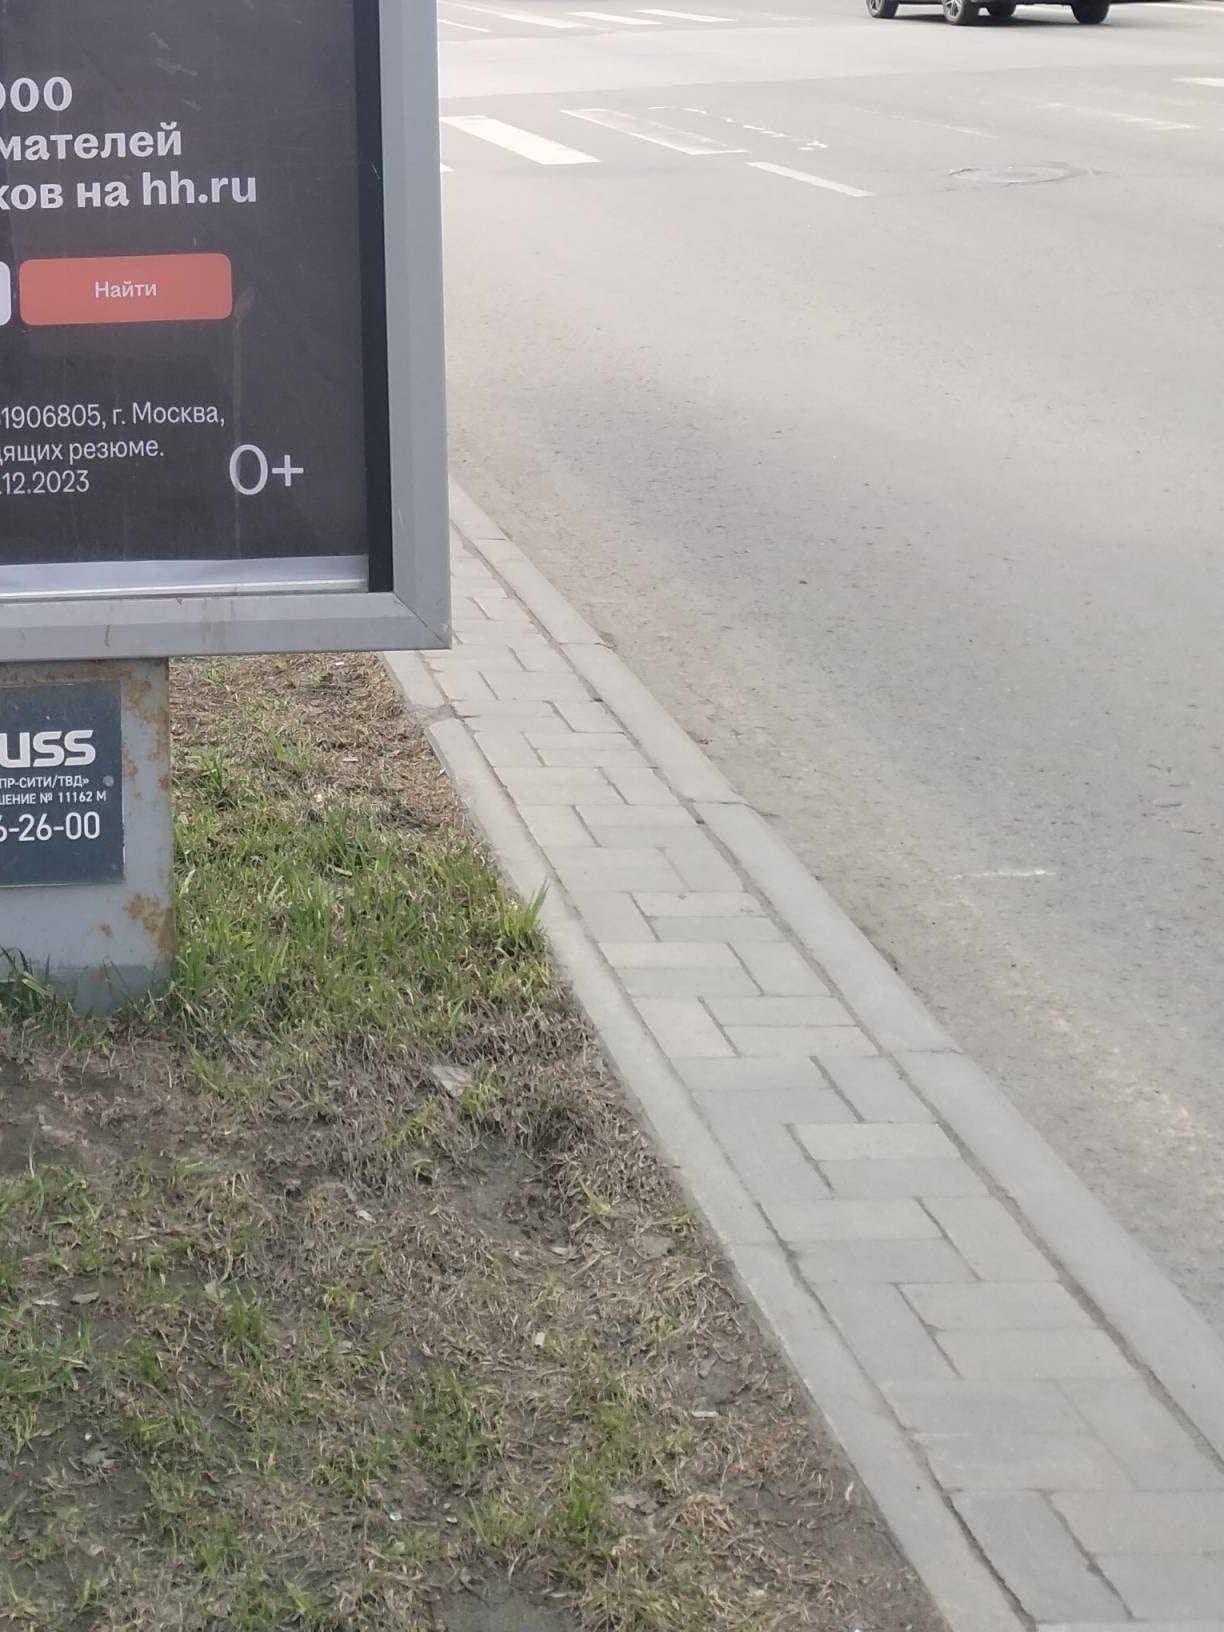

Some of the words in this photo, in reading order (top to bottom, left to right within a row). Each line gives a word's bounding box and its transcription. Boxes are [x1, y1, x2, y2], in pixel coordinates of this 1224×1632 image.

[76, 181, 130, 208] на
[142, 170, 257, 206] hh.ru
[95, 280, 157, 298] Найти
[112, 408, 126, 425] г.
[132, 401, 225, 427] Москва,
[69, 439, 164, 466] резюме.
[39, 792, 53, 804] №
[58, 790, 93, 804] 11162
[96, 790, 107, 802] М
